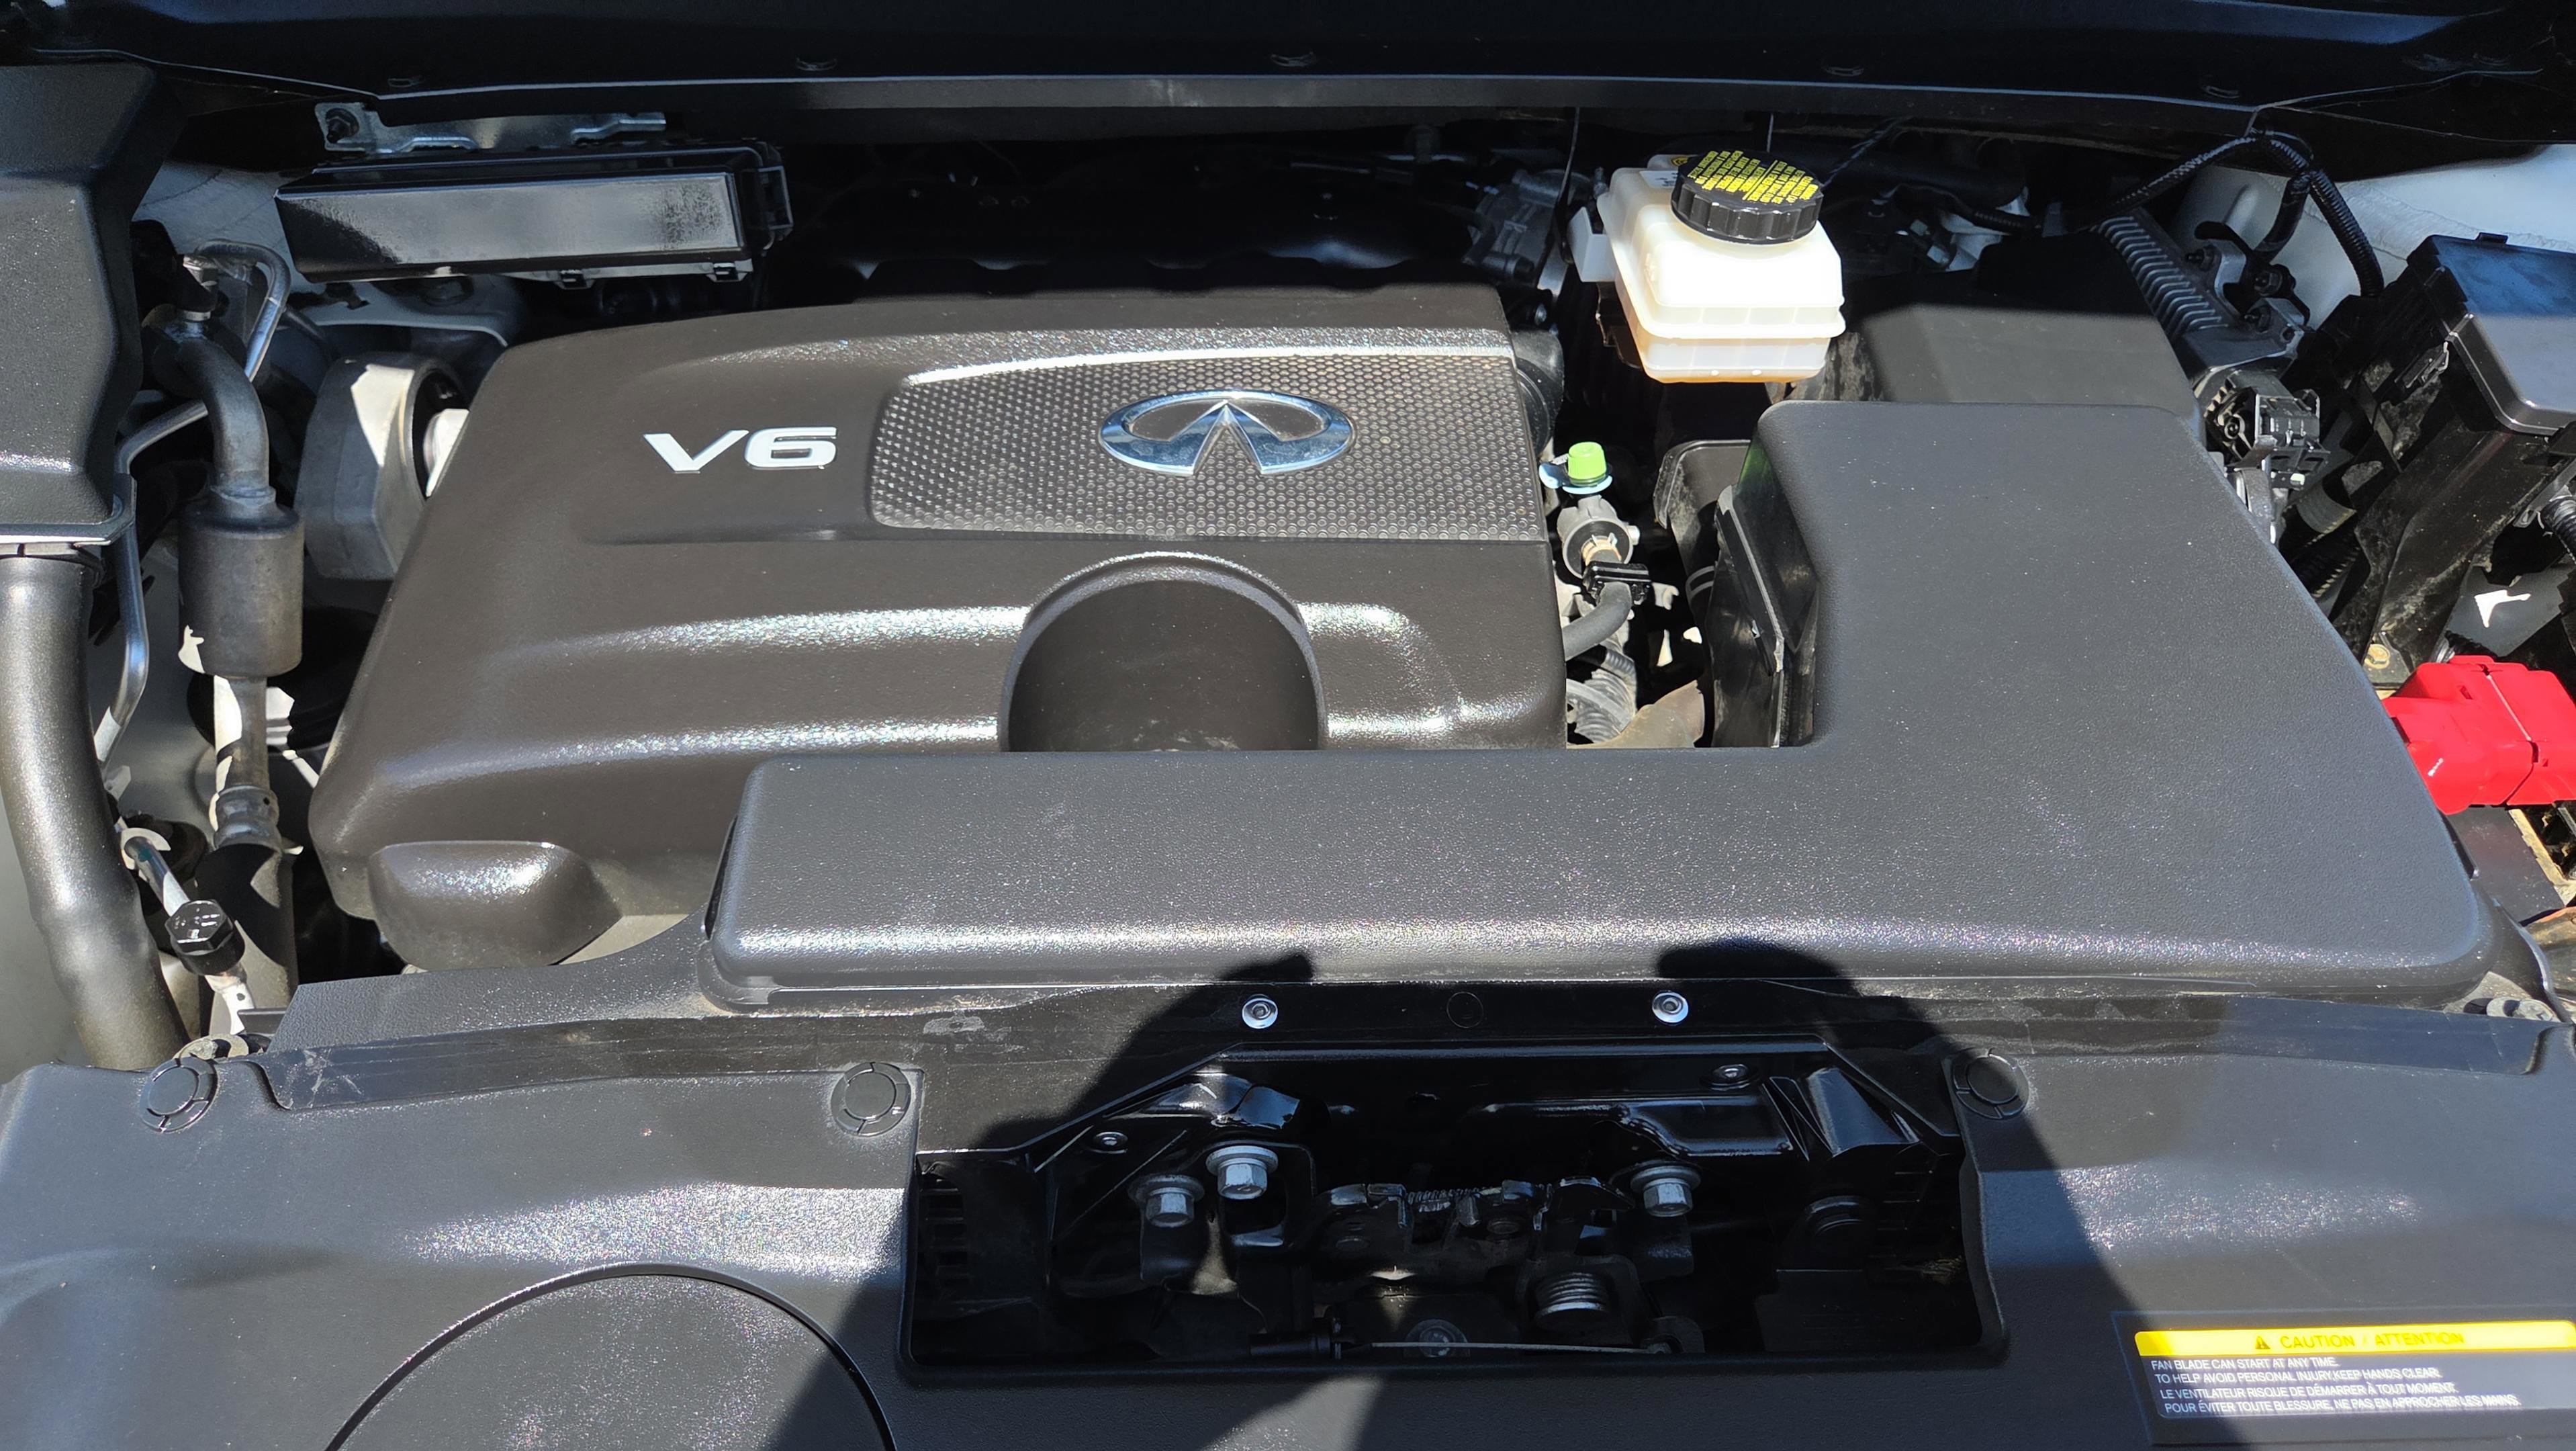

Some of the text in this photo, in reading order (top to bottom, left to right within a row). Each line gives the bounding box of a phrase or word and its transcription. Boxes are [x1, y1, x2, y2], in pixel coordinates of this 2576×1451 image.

[643, 426, 837, 474] V6
[2279, 1335, 2355, 1350] CAUTION
[2374, 1331, 2465, 1346] ATTENTION
[2150, 1356, 2340, 1370] FAN BLADE CAN START AT ANY TIME.
[2154, 1374, 2171, 1384] TO
[2172, 1373, 2201, 1383] HELP
[2236, 1370, 2295, 1382] PERSONAL
[2362, 1368, 2401, 1379] HANDS
[2401, 1367, 2443, 1378] CLEAR.
[2160, 1381, 2459, 1399] LE VENTILATEUR RISQUE DE DÉMARRER À TOUT MOMENT.
[2164, 1393, 2522, 1413] POUR ÉVITER TOUTE BLESSURE, NE PAS EN APPROCHER LES MAINS.
